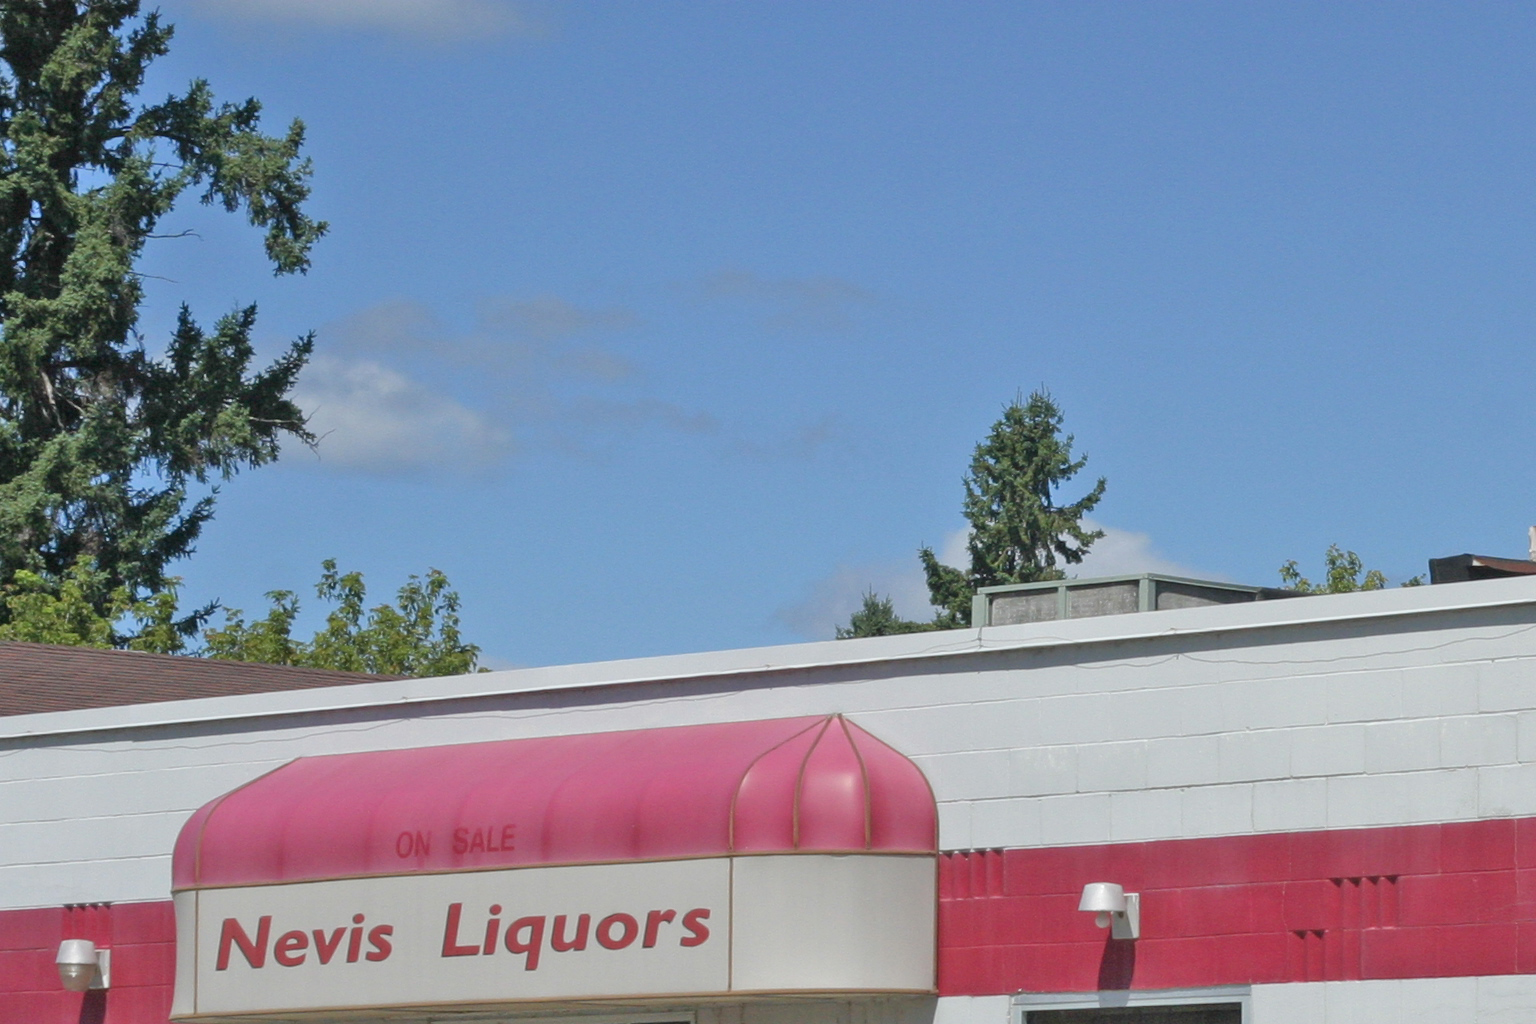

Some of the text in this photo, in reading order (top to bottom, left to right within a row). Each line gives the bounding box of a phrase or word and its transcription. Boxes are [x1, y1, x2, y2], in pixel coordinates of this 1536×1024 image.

[396, 824, 516, 858] ON SALE
[215, 902, 711, 971] Nevis Liquors
